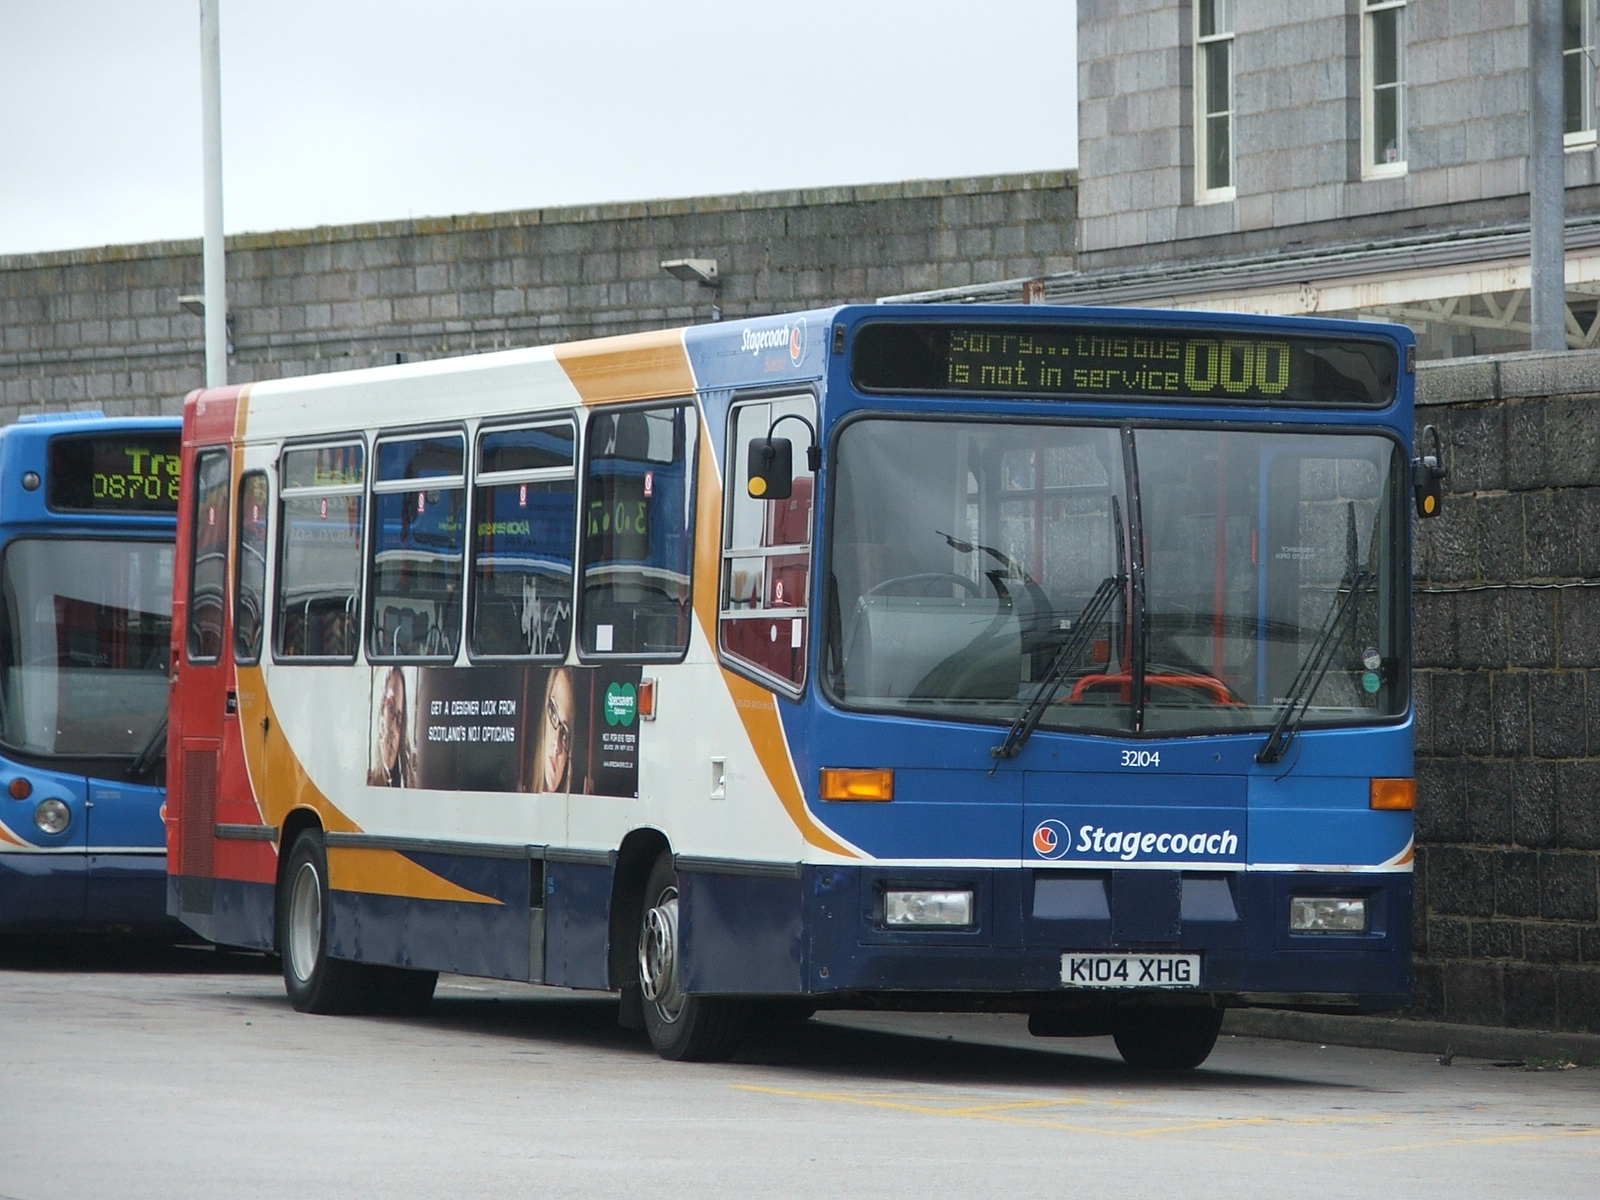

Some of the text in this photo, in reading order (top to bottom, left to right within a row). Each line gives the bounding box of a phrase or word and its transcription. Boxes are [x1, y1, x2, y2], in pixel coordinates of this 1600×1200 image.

[741, 324, 789, 356] Stagecoach
[948, 357, 1179, 391] is not in service
[1184, 339, 1290, 394] 000
[92, 473, 161, 499] 0870
[431, 701, 516, 715] GET A DESIGNER LOOK FROM
[428, 725, 466, 742] SCOTLAND'S
[482, 726, 515, 742] OPTICIANS
[1120, 750, 1160, 767] 32104
[1076, 825, 1238, 861] Stagecoach
[1070, 958, 1191, 982] K104 XHG
